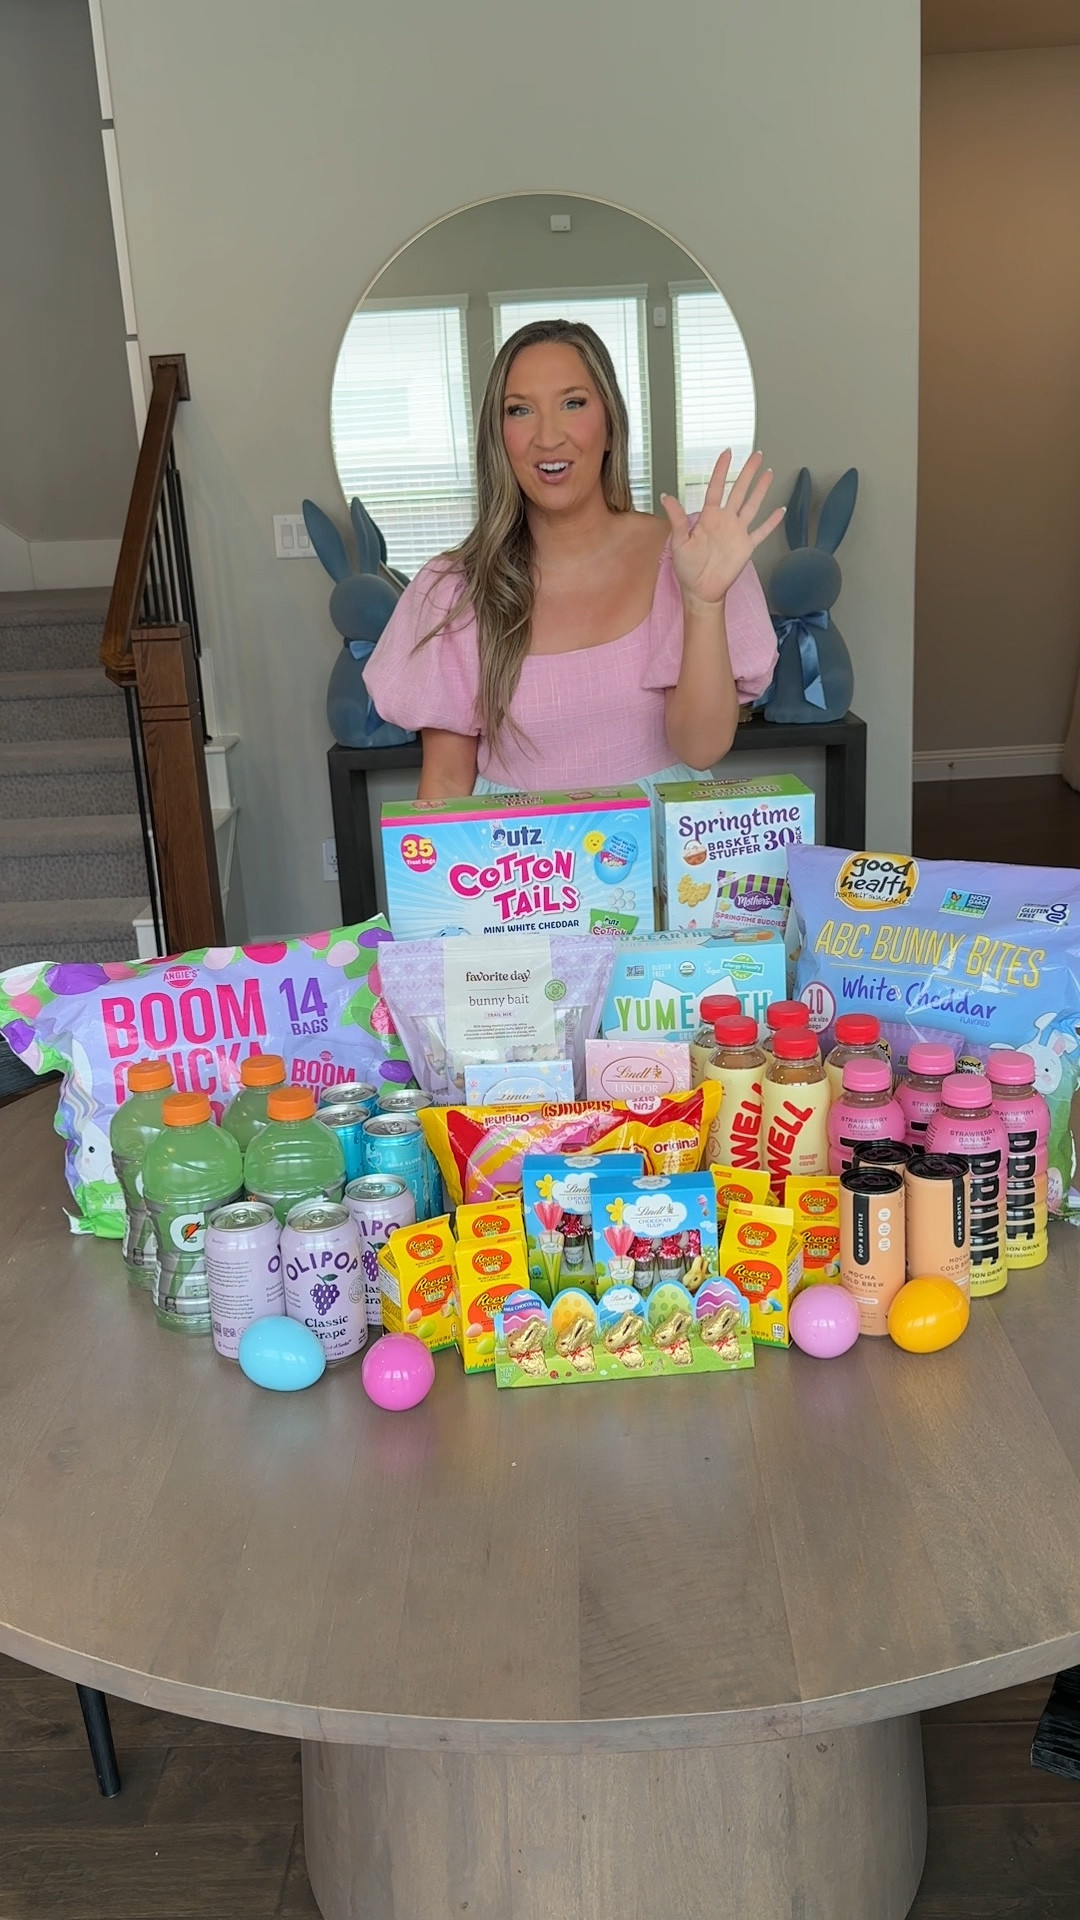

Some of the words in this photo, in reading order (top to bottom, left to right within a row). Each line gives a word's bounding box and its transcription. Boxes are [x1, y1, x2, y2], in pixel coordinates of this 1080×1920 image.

[679, 805, 800, 844] Springtime
[708, 834, 760, 850] BASKET
[763, 828, 795, 851] 30
[402, 838, 434, 858] 35
[709, 844, 761, 860] STUFFER
[449, 850, 573, 897] COTTON
[850, 858, 914, 877] good
[840, 876, 912, 897] health
[970, 894, 989, 902] NON
[483, 926, 505, 934] MINI
[507, 924, 536, 933] WHITE
[538, 920, 580, 931] CHEDDAR
[715, 911, 757, 924] SPRINGTIME
[757, 918, 787, 927] BUDDIES
[620, 931, 704, 942] UMEARTH
[814, 920, 871, 958] ABC
[870, 925, 967, 971] BUNNY
[966, 933, 1046, 988] BITES
[163, 969, 198, 982] ANGIE'S
[465, 971, 508, 982] favorite
[510, 969, 531, 982] day
[279, 977, 329, 1022] 14
[469, 996, 505, 1007] bunny
[507, 993, 529, 1005] bait
[808, 988, 824, 1014] 10
[842, 975, 899, 1002] White
[905, 982, 997, 1019] Cheddar
[101, 978, 268, 1059] BOOM
[616, 992, 769, 1032] YUMETH
[290, 1018, 329, 1036] BAGS
[959, 1016, 991, 1027] FLAVORED
[291, 1058, 356, 1087] BOOM
[614, 1065, 652, 1080] Lindt
[615, 1083, 659, 1094] LINDOR
[633, 1103, 655, 1111] FUN
[994, 1109, 1034, 1117] RAWBERRY
[484, 1113, 530, 1127] Original
[950, 1128, 996, 1137] STRAWBERRY
[958, 1136, 992, 1144] BANANA
[653, 1136, 699, 1154] Original
[635, 1205, 666, 1216] Lindt
[170, 1212, 206, 1252] G
[286, 1251, 358, 1281] OLIPOP
[732, 1263, 772, 1281] Reese's
[848, 1270, 876, 1281] MOCHA
[304, 1315, 349, 1328] Classic
